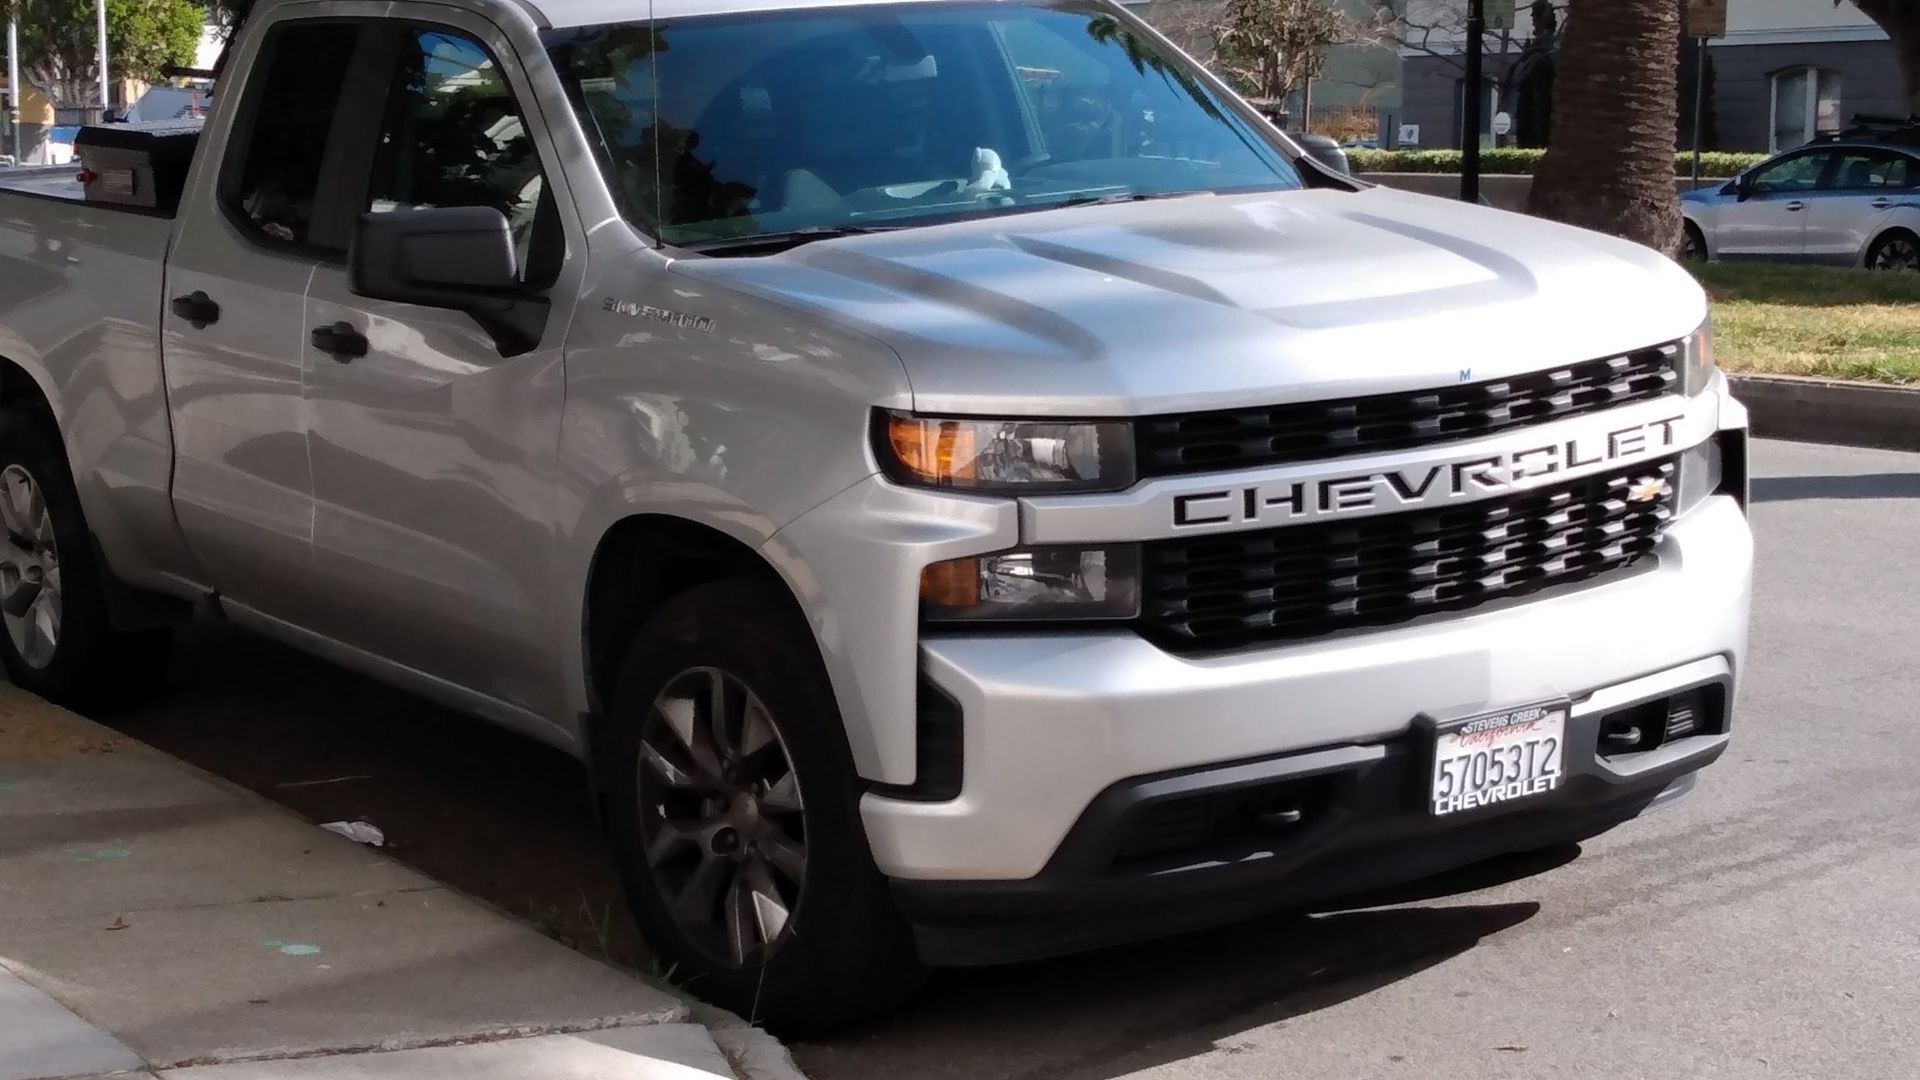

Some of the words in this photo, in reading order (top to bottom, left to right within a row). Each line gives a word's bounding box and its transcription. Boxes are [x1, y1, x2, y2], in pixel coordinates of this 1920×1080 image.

[1172, 414, 1684, 527] CHEVROLET
[1460, 720, 1542, 747] California
[1466, 715, 1508, 734] STEVENS
[1510, 708, 1541, 725] CREEK
[1439, 737, 1557, 798] 57053T2
[1434, 770, 1561, 815] CHEVROLET
